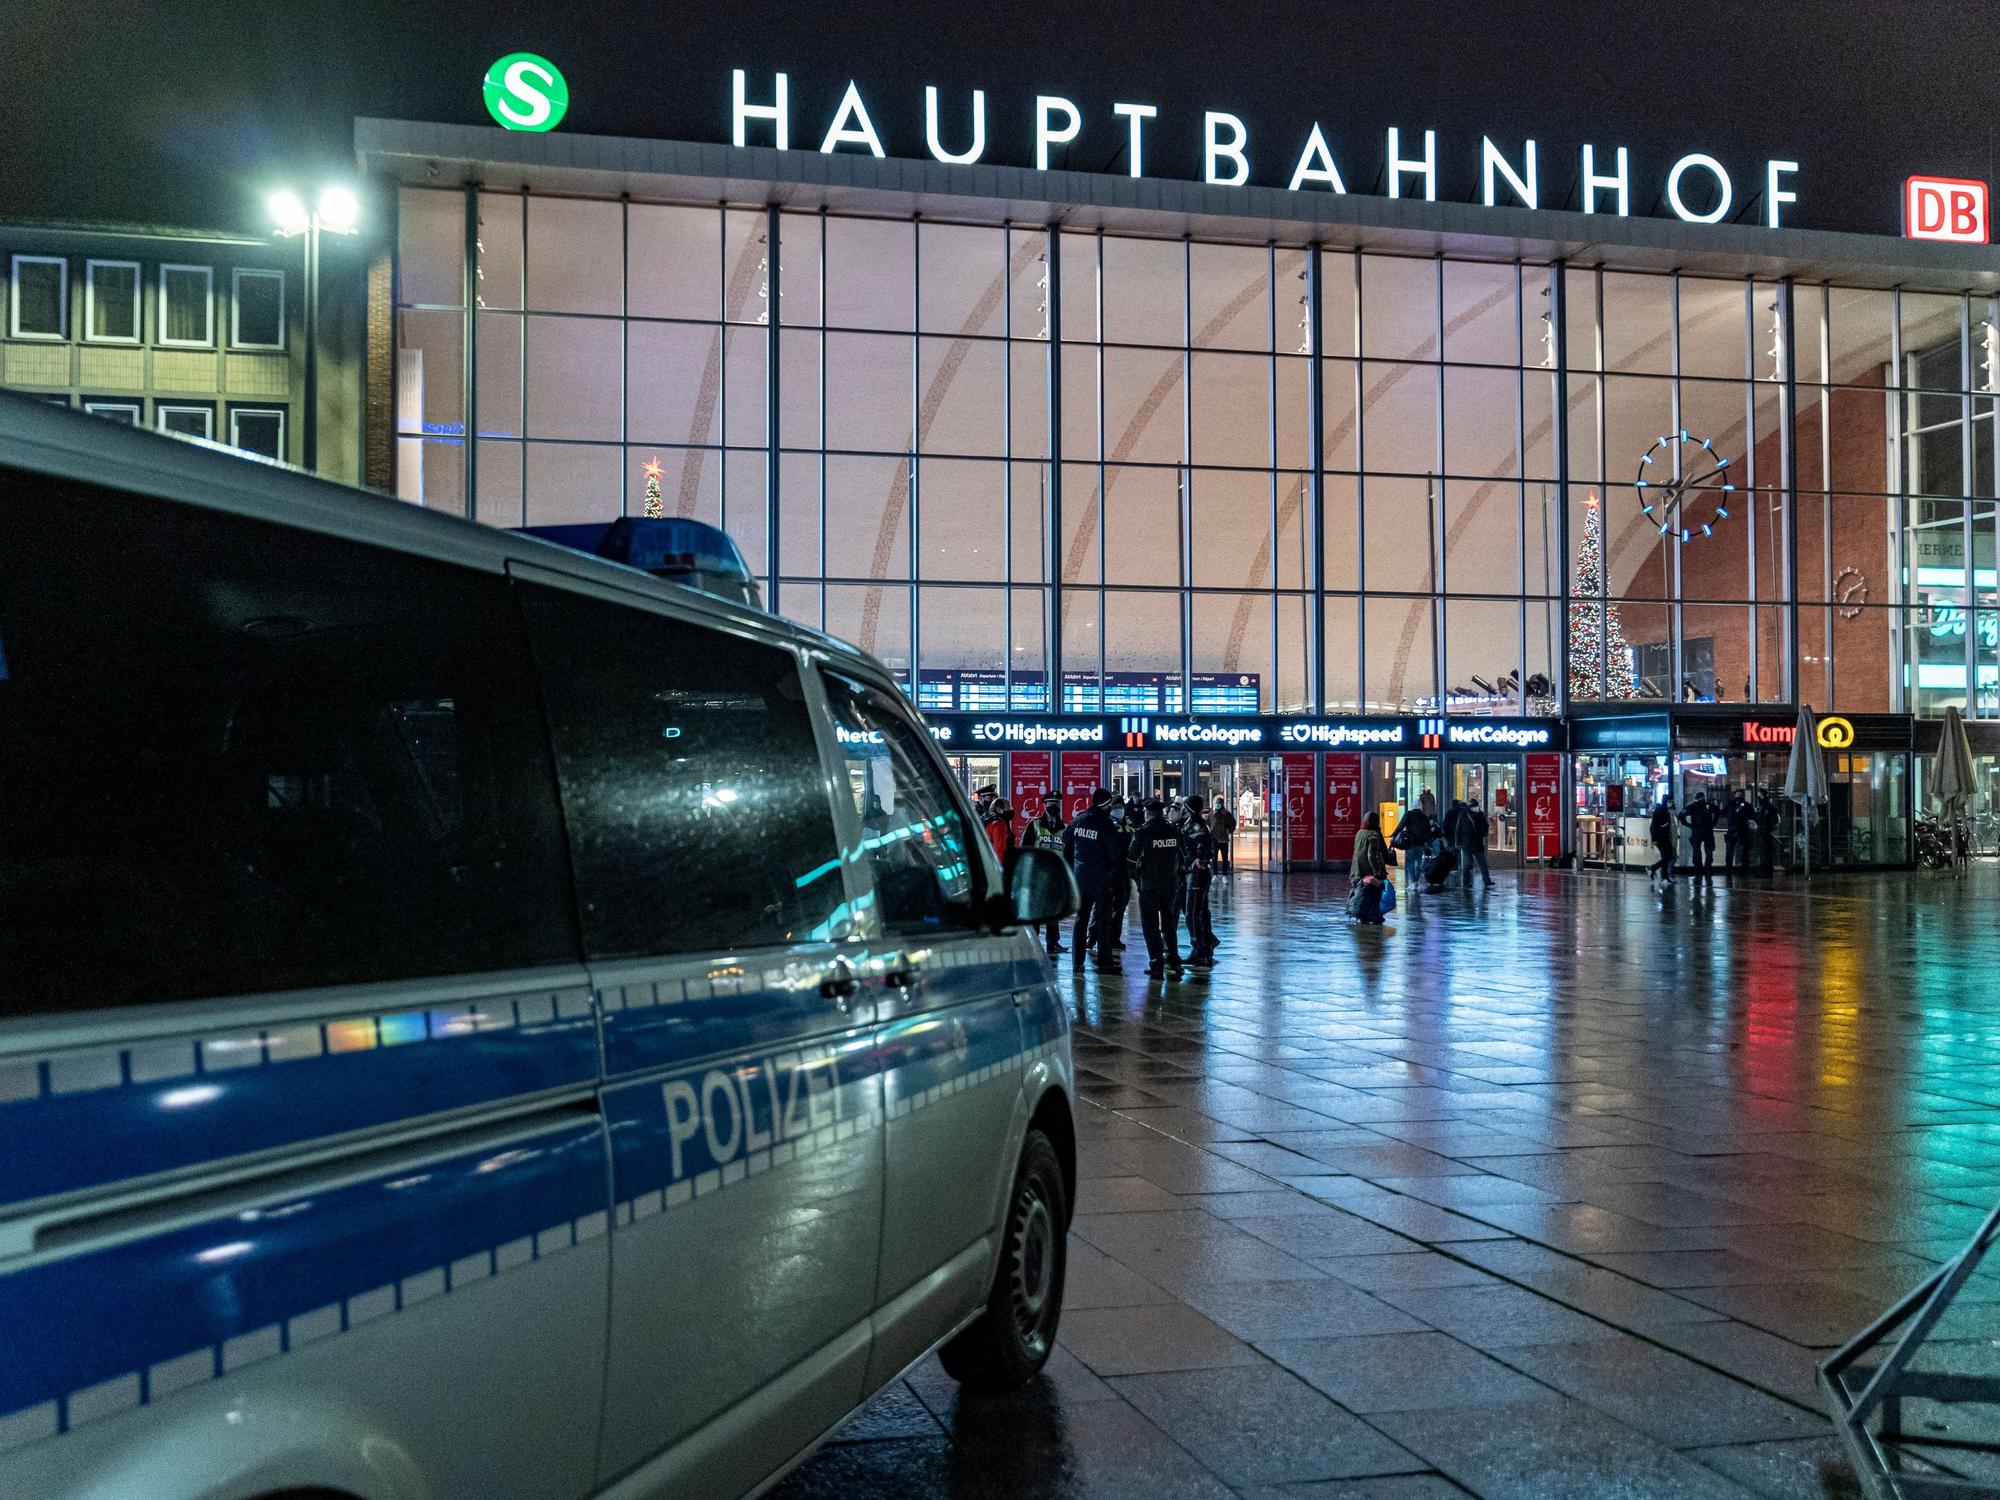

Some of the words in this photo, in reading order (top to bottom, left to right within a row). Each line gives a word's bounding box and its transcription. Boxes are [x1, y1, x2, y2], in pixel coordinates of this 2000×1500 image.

[498, 61, 553, 126] S
[732, 69, 1799, 228] HAUPTBAHNHOF
[1917, 187, 1978, 235] DB
[1918, 543, 1963, 557] HERME
[1005, 723, 1103, 744] Highspeed
[1155, 724, 1262, 745] NetCologne
[1311, 726, 1403, 745] Highspeed
[1450, 726, 1549, 746] NetCologne
[1743, 722, 1797, 746] Kam
[1039, 835, 1063, 844] POLIZ
[1073, 827, 1098, 840] POLIZEI
[1152, 838, 1177, 848] POLIZEI
[662, 1057, 842, 1179] POLIZEI
